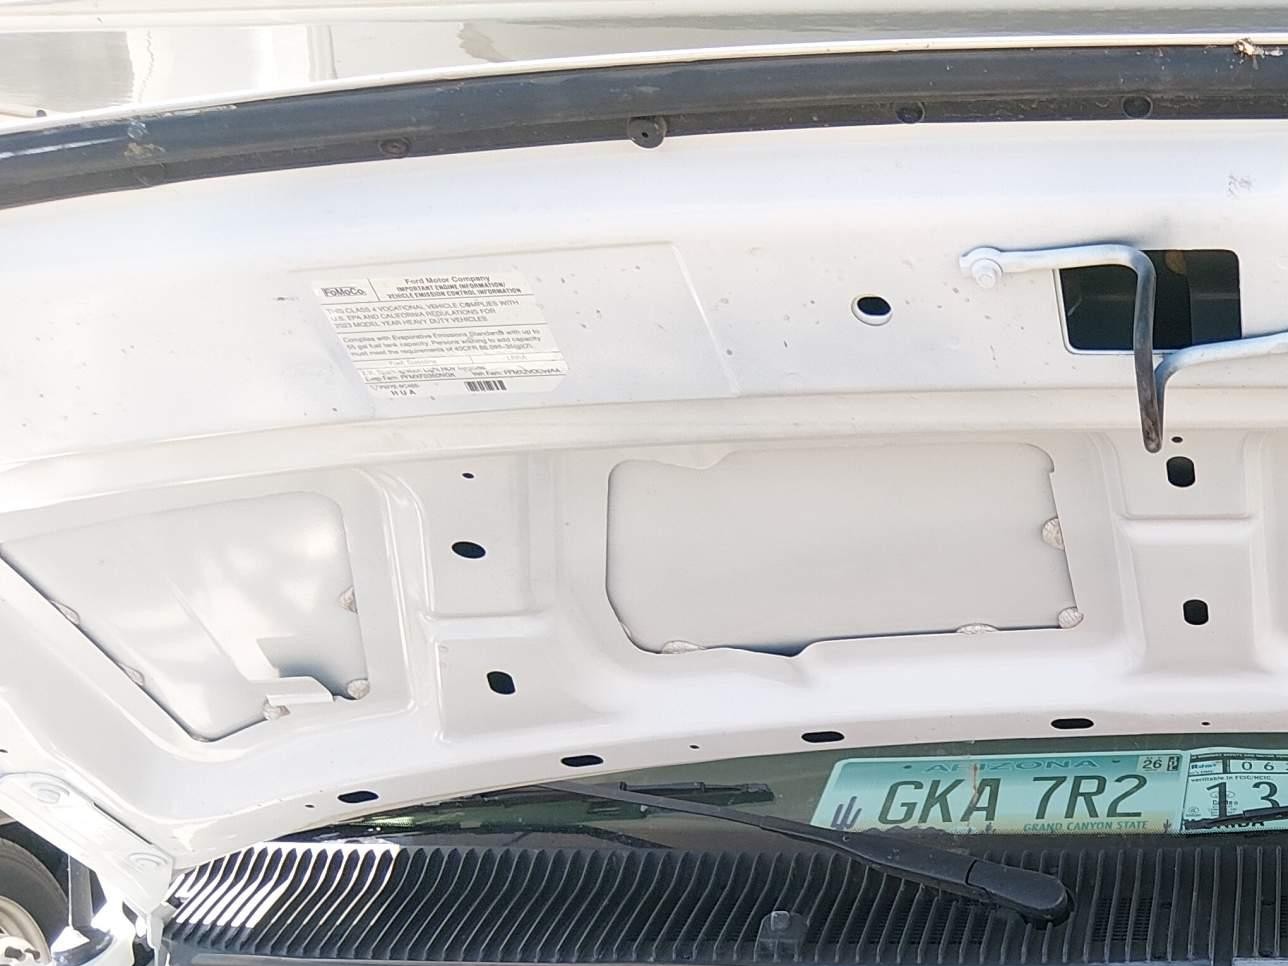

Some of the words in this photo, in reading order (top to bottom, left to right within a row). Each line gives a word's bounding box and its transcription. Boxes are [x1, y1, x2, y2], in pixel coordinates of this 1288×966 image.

[321, 287, 366, 297] FoMoCo
[926, 759, 1098, 772] ARIZONA
[1142, 759, 1162, 769] 26
[878, 778, 1001, 824] GKA
[1033, 773, 1147, 820] 7R2
[1023, 823, 1063, 833] GRAND
[1067, 821, 1113, 831] CANYON
[1116, 820, 1149, 830] STATE
